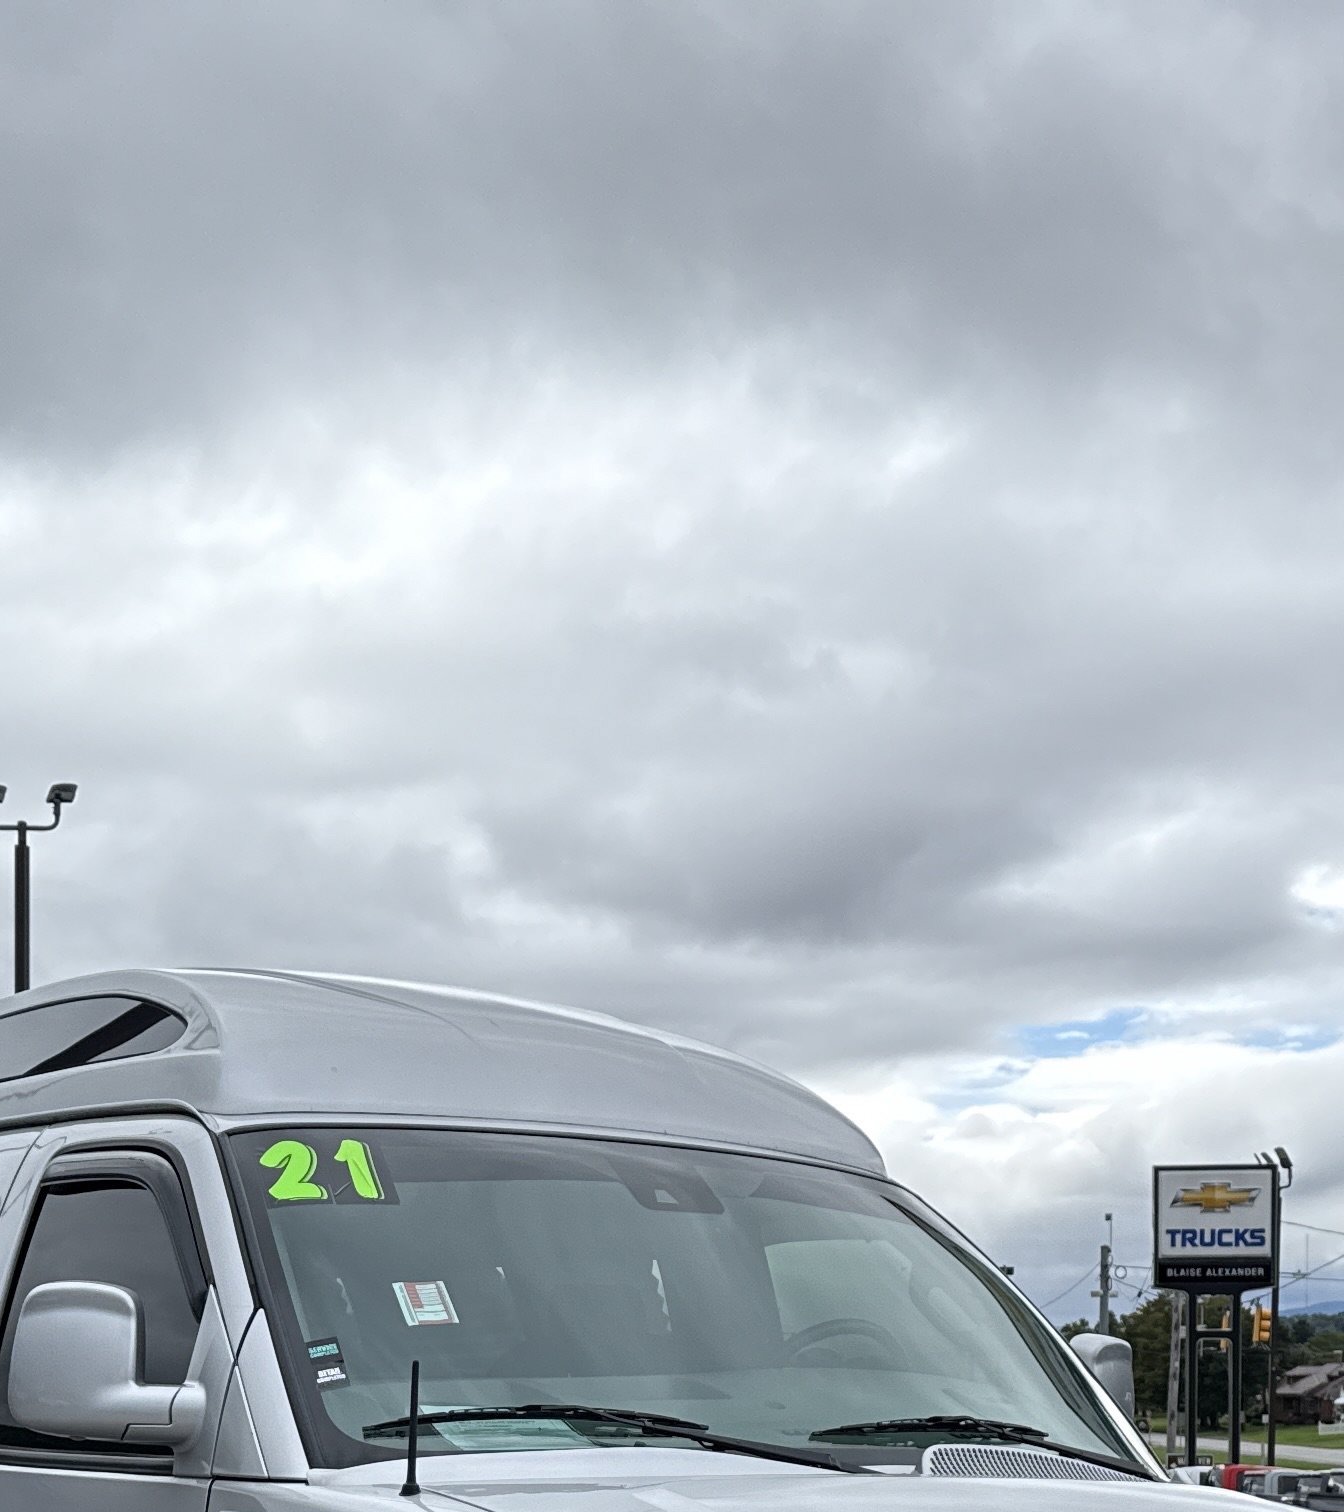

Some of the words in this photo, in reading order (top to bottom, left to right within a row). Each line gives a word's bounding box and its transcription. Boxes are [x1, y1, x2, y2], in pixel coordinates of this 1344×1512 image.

[259, 1139, 384, 1200] 21
[1165, 1228, 1266, 1248] TRUCKS
[1167, 1267, 1202, 1278] BLAISE
[1205, 1266, 1265, 1278] ALEXANDER
